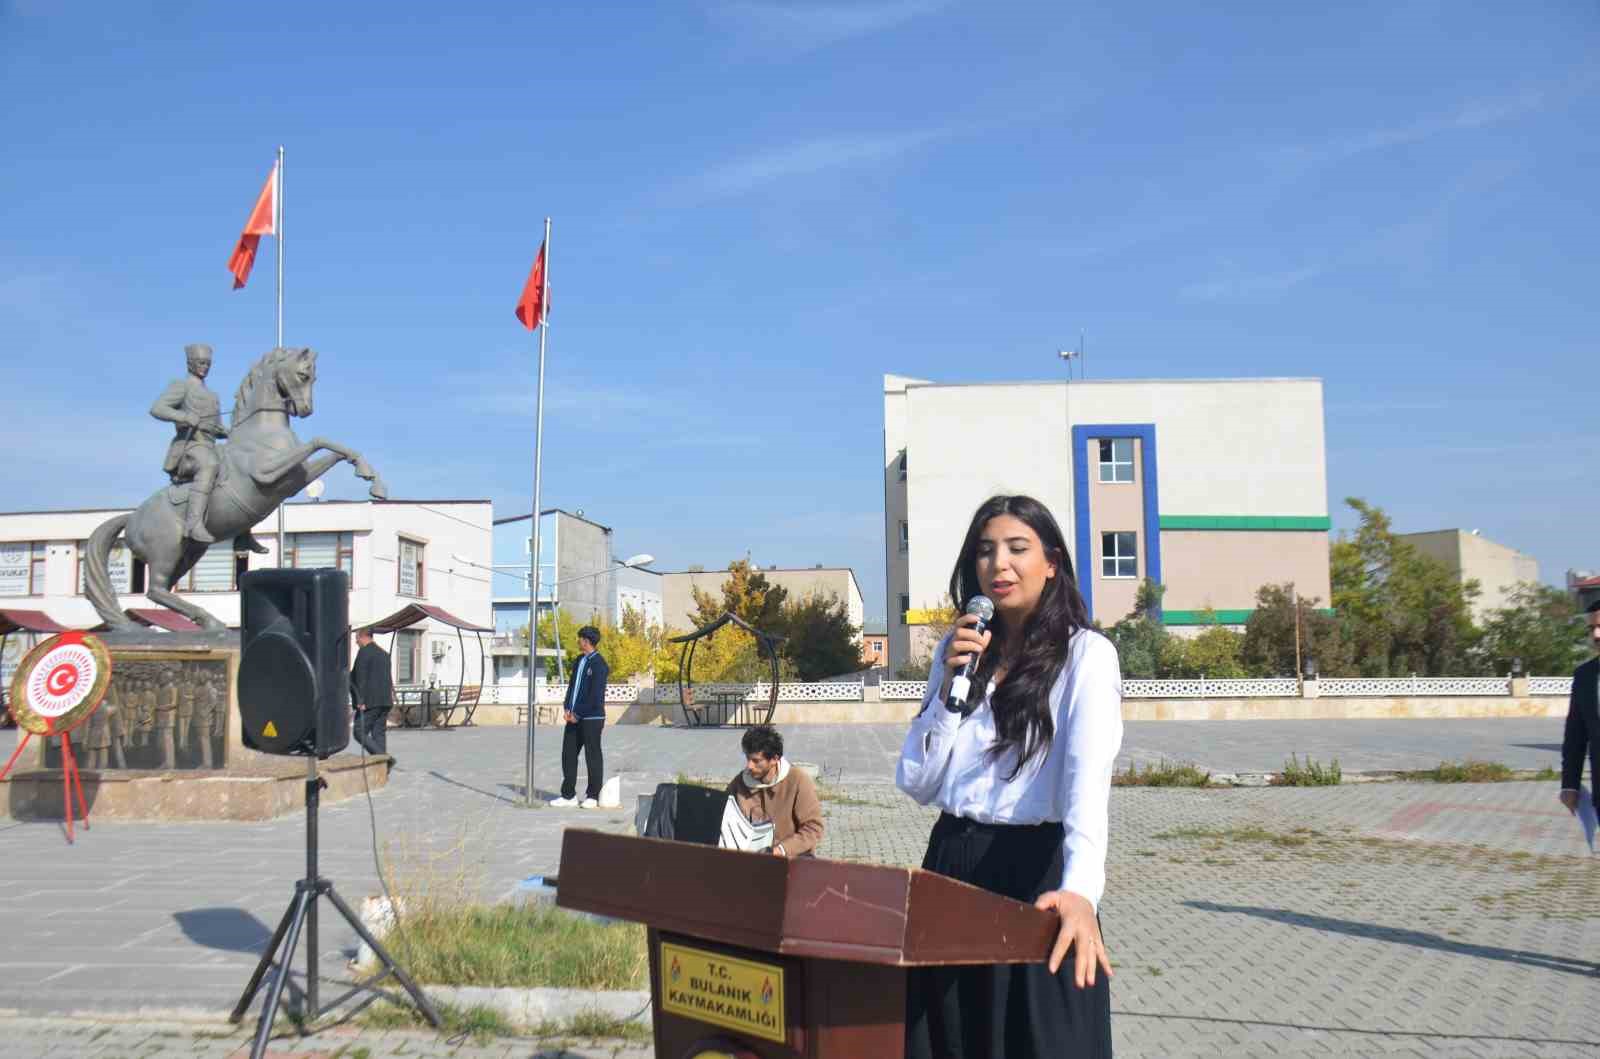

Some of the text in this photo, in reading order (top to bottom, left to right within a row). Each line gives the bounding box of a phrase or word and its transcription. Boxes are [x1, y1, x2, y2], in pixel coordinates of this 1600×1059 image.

[0, 568, 28, 577] VUKAT
[707, 963, 732, 980] T.C.
[690, 977, 751, 1003] BULANIK
[669, 990, 776, 1029] KAYMAKAMLIĞI
